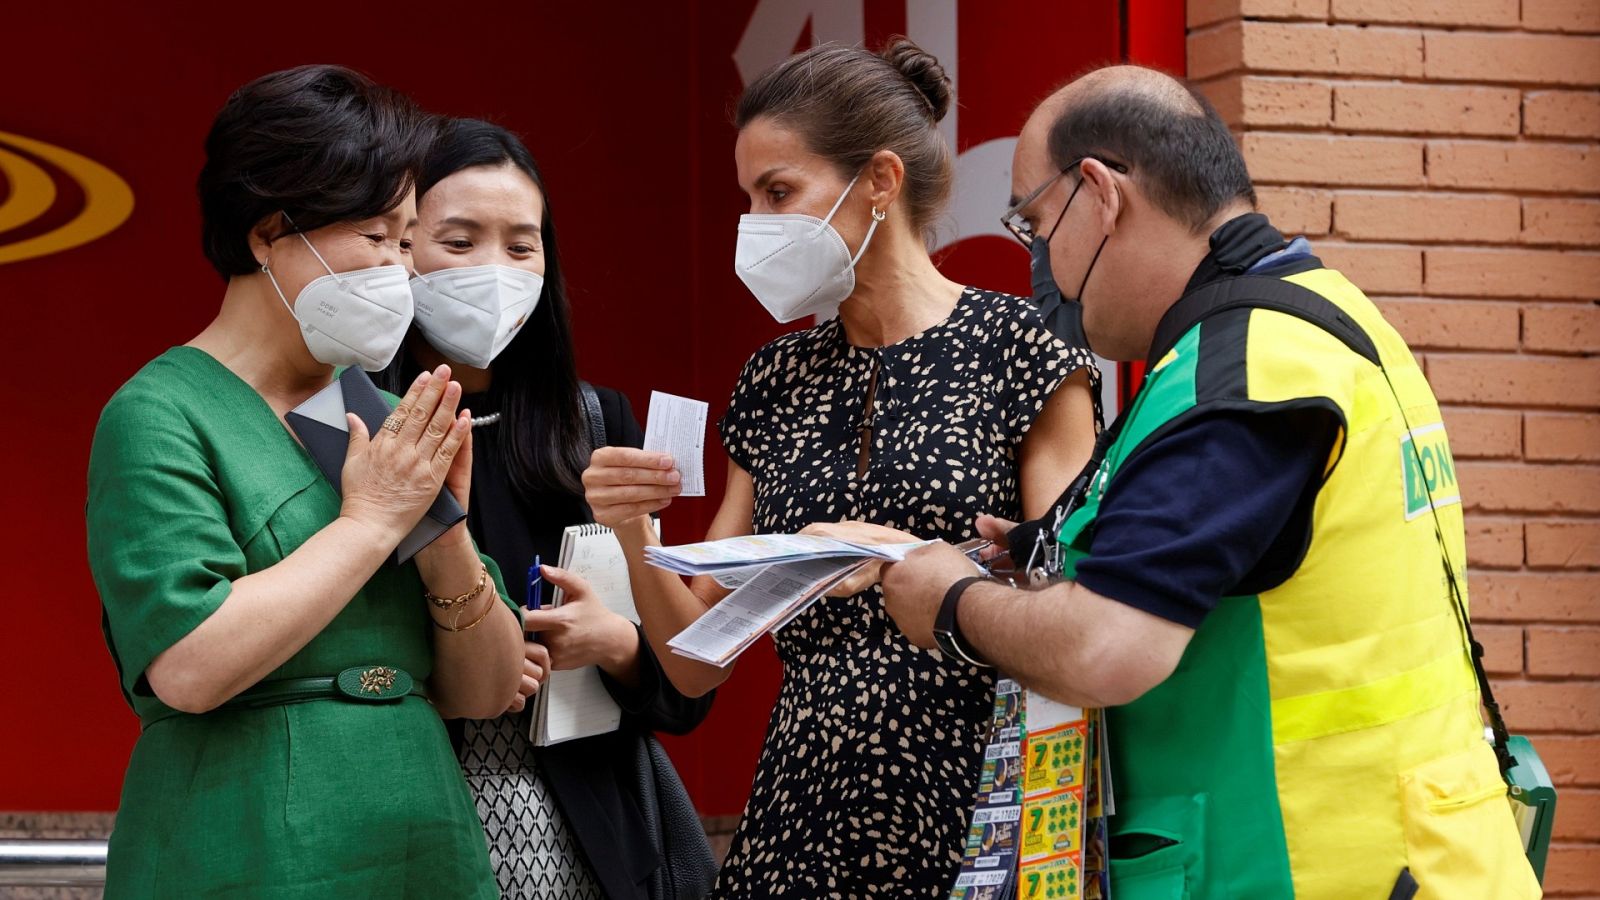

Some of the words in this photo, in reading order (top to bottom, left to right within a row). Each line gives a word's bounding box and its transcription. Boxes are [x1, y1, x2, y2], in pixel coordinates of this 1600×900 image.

[1034, 743, 1048, 767] 7
[1030, 807, 1044, 832] 7
[1027, 871, 1041, 897] 7
